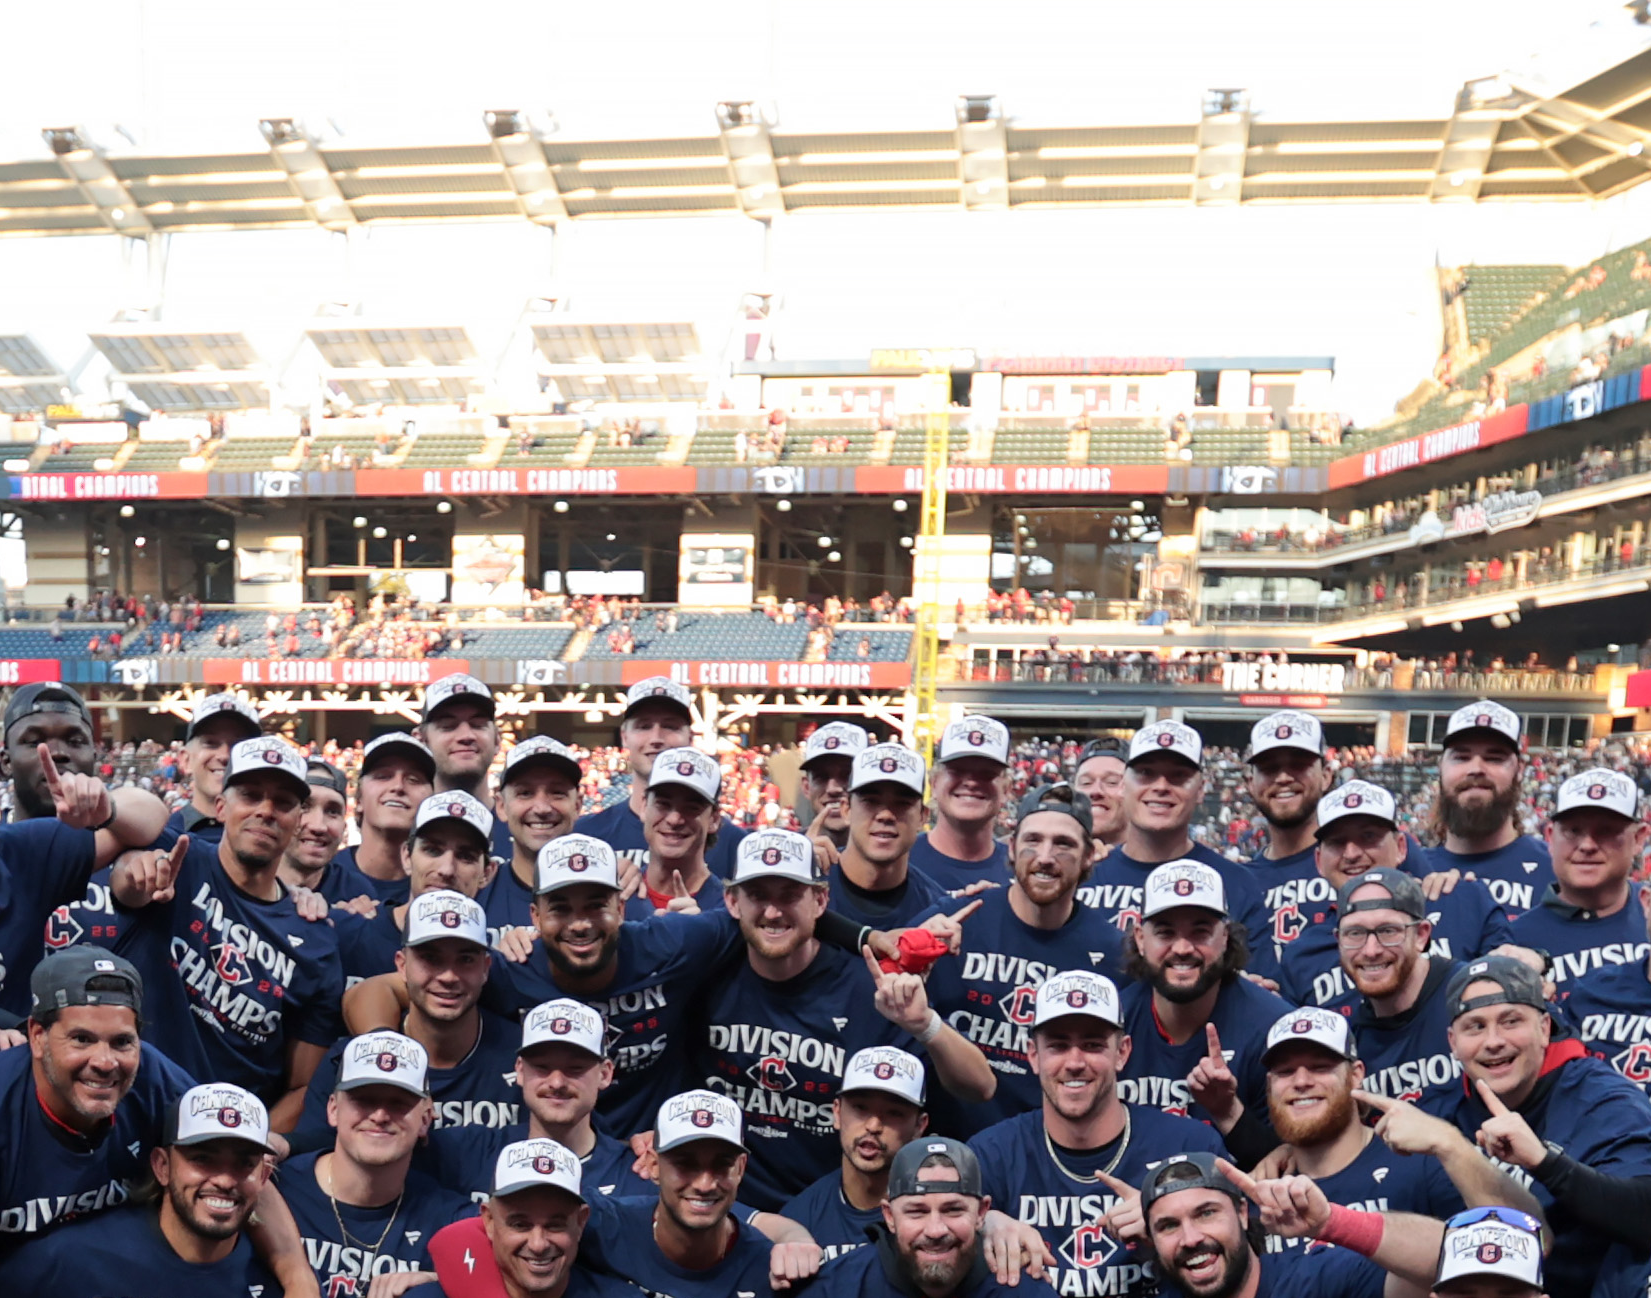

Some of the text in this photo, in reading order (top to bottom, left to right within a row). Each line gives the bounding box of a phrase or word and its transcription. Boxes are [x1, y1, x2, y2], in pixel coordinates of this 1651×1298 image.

[938, 468, 1006, 490] ENTRAL
[1222, 662, 1345, 693] THE CORNER
[1076, 885, 1142, 909] DIVIS
[170, 935, 281, 1036] CHAMPS
[354, 1042, 420, 1068] CHAMPIONS
[709, 1025, 845, 1073] DIVISION
[191, 1096, 262, 1123] CHAMPIONS
[668, 1099, 736, 1124] CHAMPIONS
[706, 1077, 834, 1124] CHAMPS
[508, 1147, 576, 1174] CHAMPIONS
[1074, 1223, 1105, 1268] C
